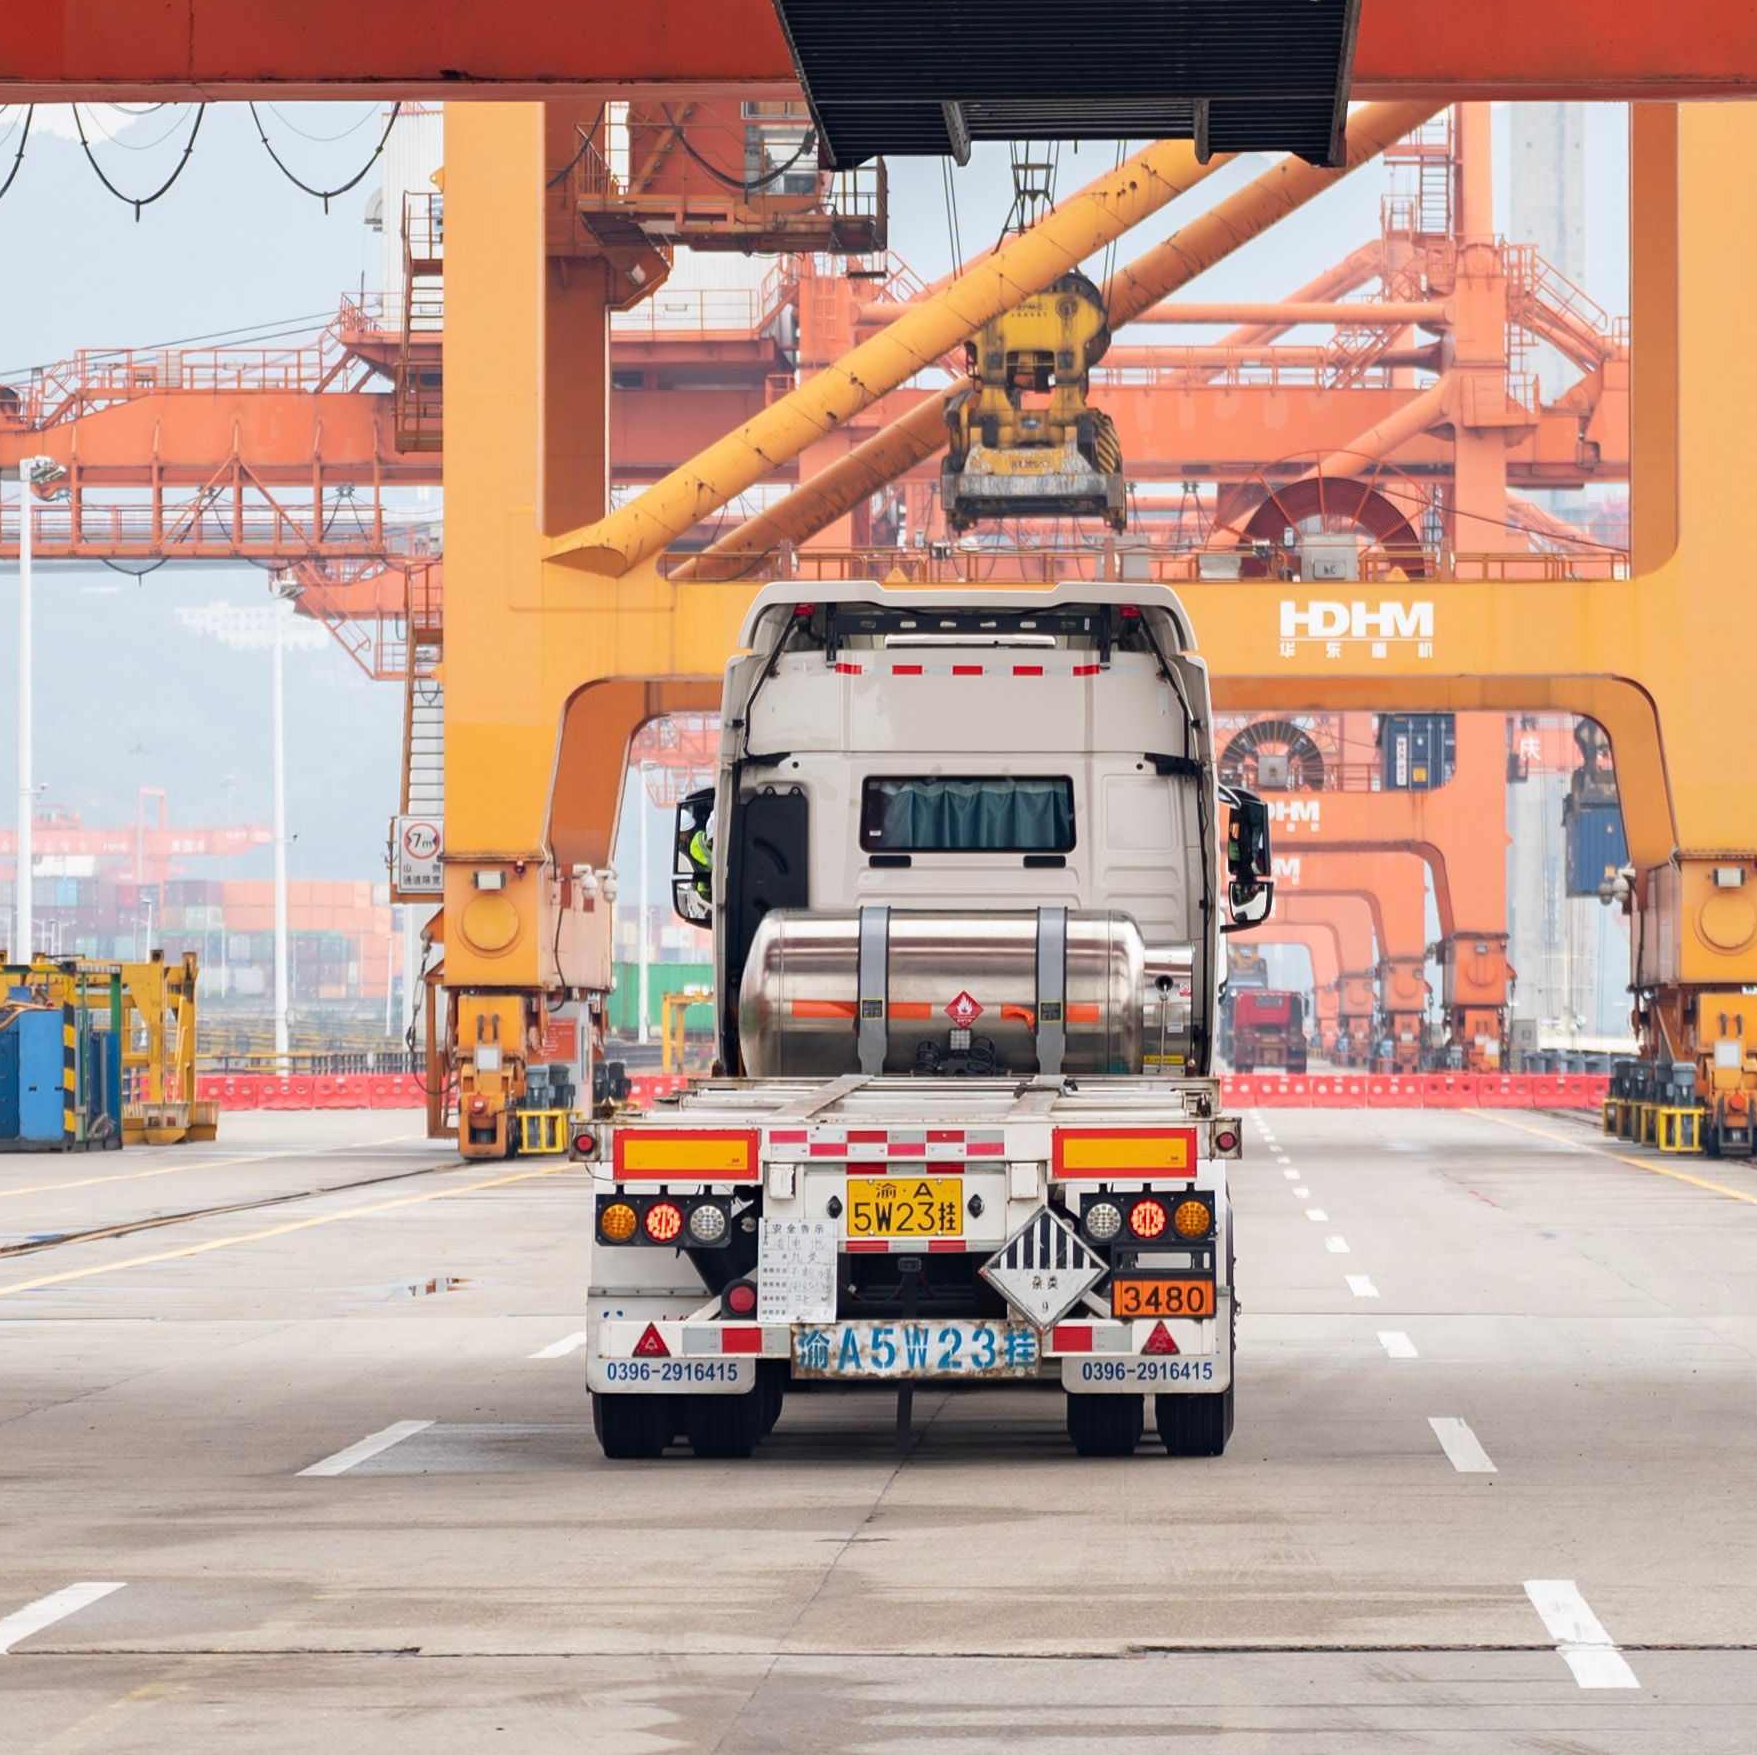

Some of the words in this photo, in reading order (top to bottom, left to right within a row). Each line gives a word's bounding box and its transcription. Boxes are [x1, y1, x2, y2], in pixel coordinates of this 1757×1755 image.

[1279, 600, 1434, 638] HDHM
[1279, 641, 1433, 659] 华东重机
[854, 1202, 957, 1232] 5W23挂
[1124, 1286, 1206, 1314] 3480
[797, 1327, 1037, 1371] 渝A5W23挂
[606, 1361, 738, 1382] 0396-2916415
[1081, 1361, 1214, 1381] 0396-2916415
